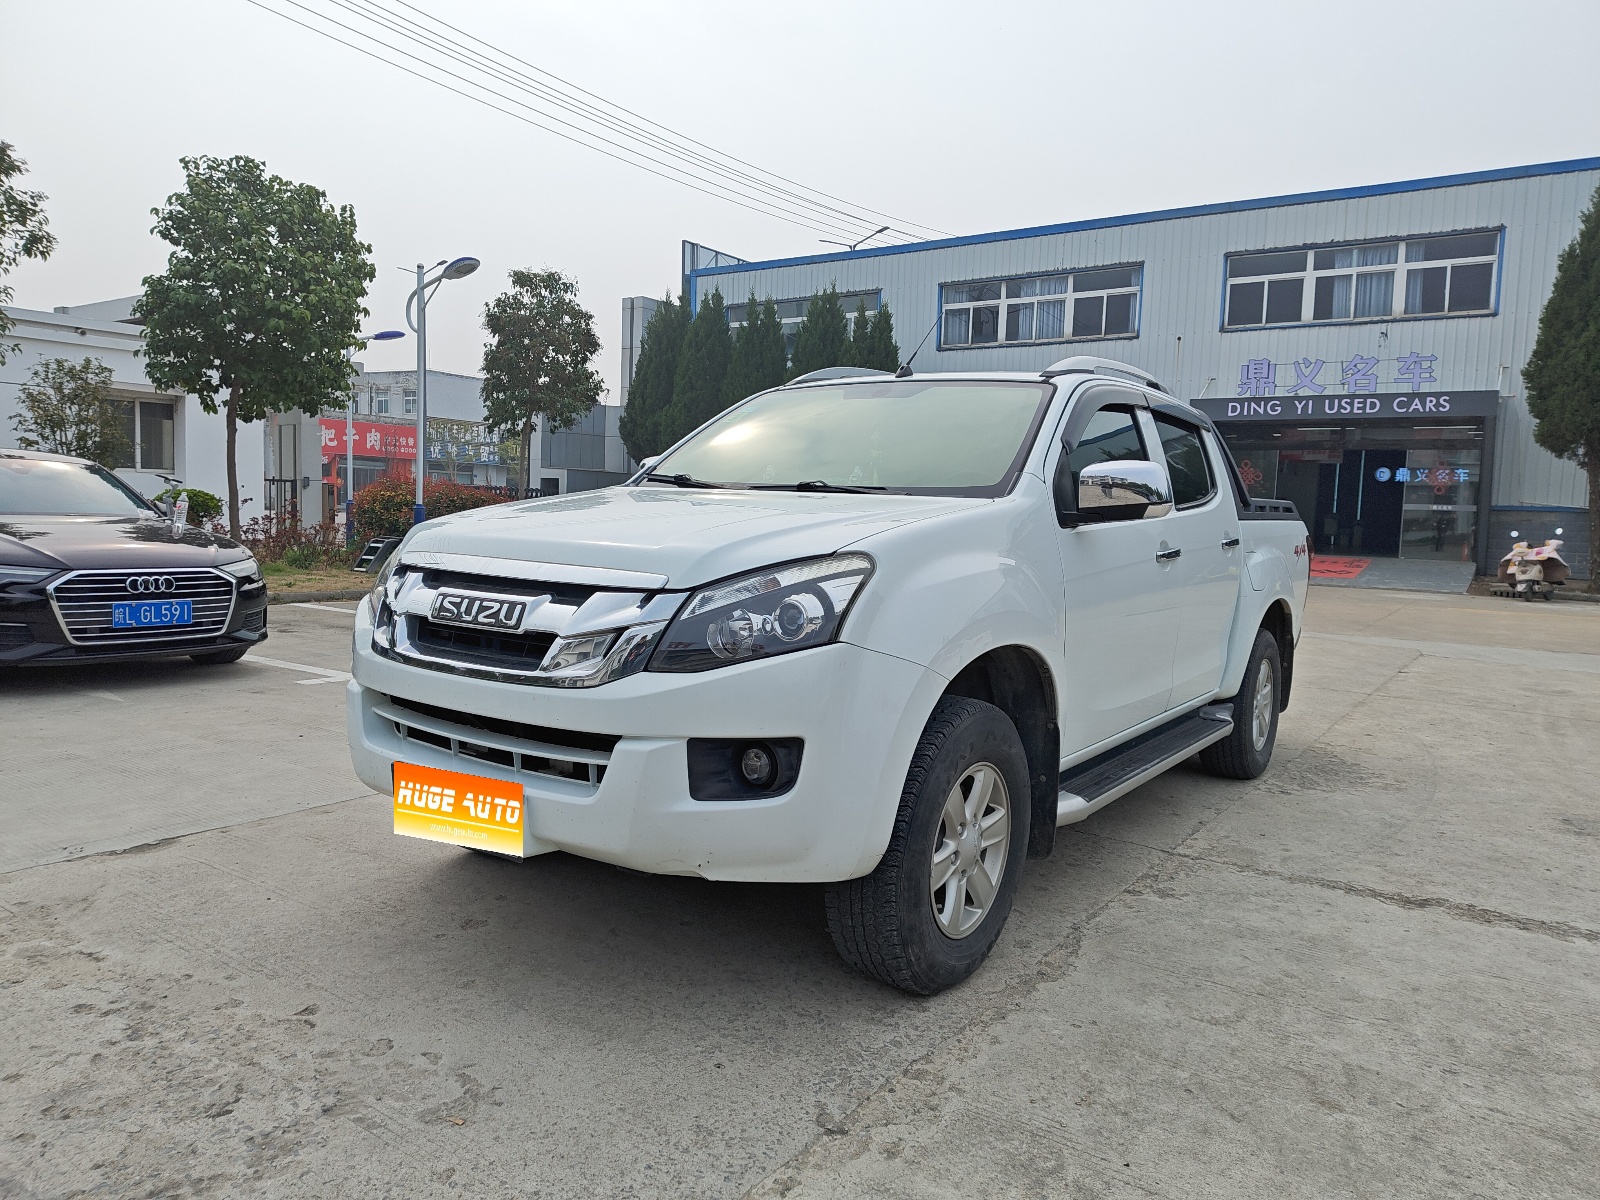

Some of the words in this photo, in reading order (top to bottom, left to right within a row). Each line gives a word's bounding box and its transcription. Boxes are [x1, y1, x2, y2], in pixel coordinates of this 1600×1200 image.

[1237, 352, 1438, 396] 鼎义名车
[1227, 400, 1282, 417] DING
[1294, 400, 1312, 415] YI
[1324, 398, 1381, 414] USED
[1392, 396, 1451, 413] CARS
[432, 595, 523, 627] ISUZU
